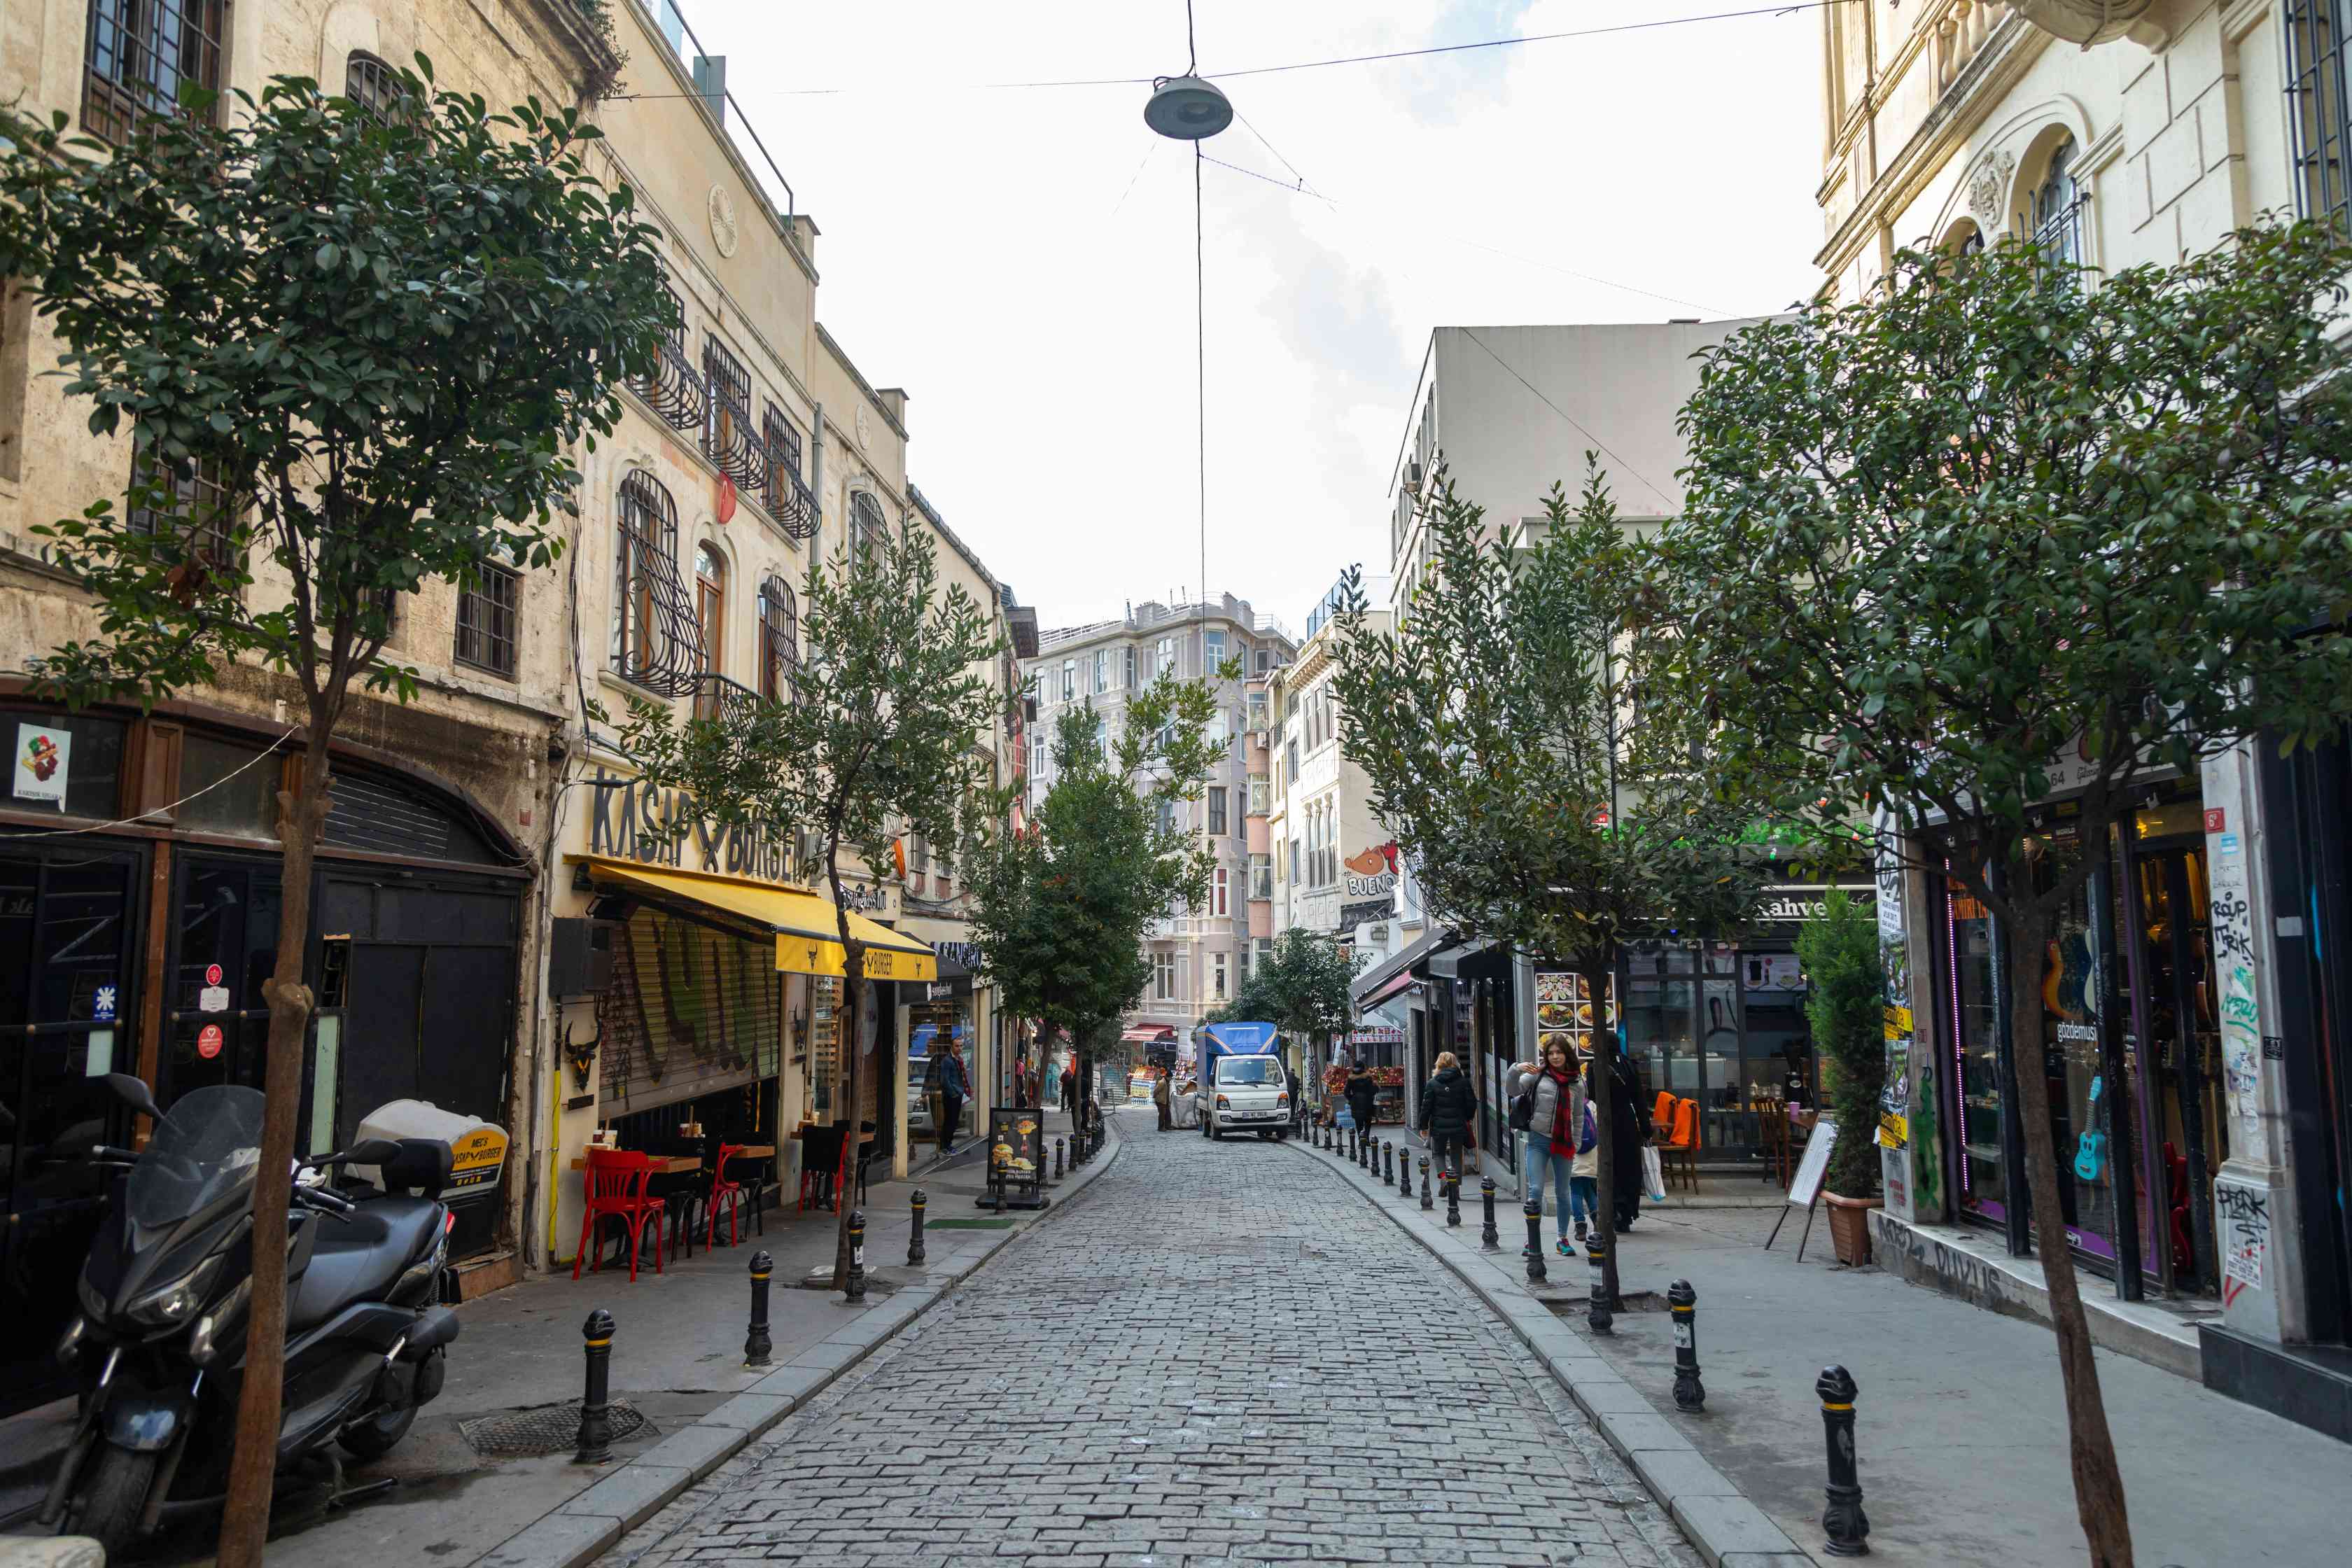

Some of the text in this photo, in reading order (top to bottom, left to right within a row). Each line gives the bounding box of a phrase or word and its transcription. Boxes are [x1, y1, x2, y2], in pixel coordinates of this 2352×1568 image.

[592, 766, 693, 868] KASAP
[1348, 873, 1398, 897] BUENO
[874, 953, 893, 975] BURGER
[2057, 1019, 2099, 1042] gözdemusi
[455, 1147, 502, 1164] ASAP BURGER
